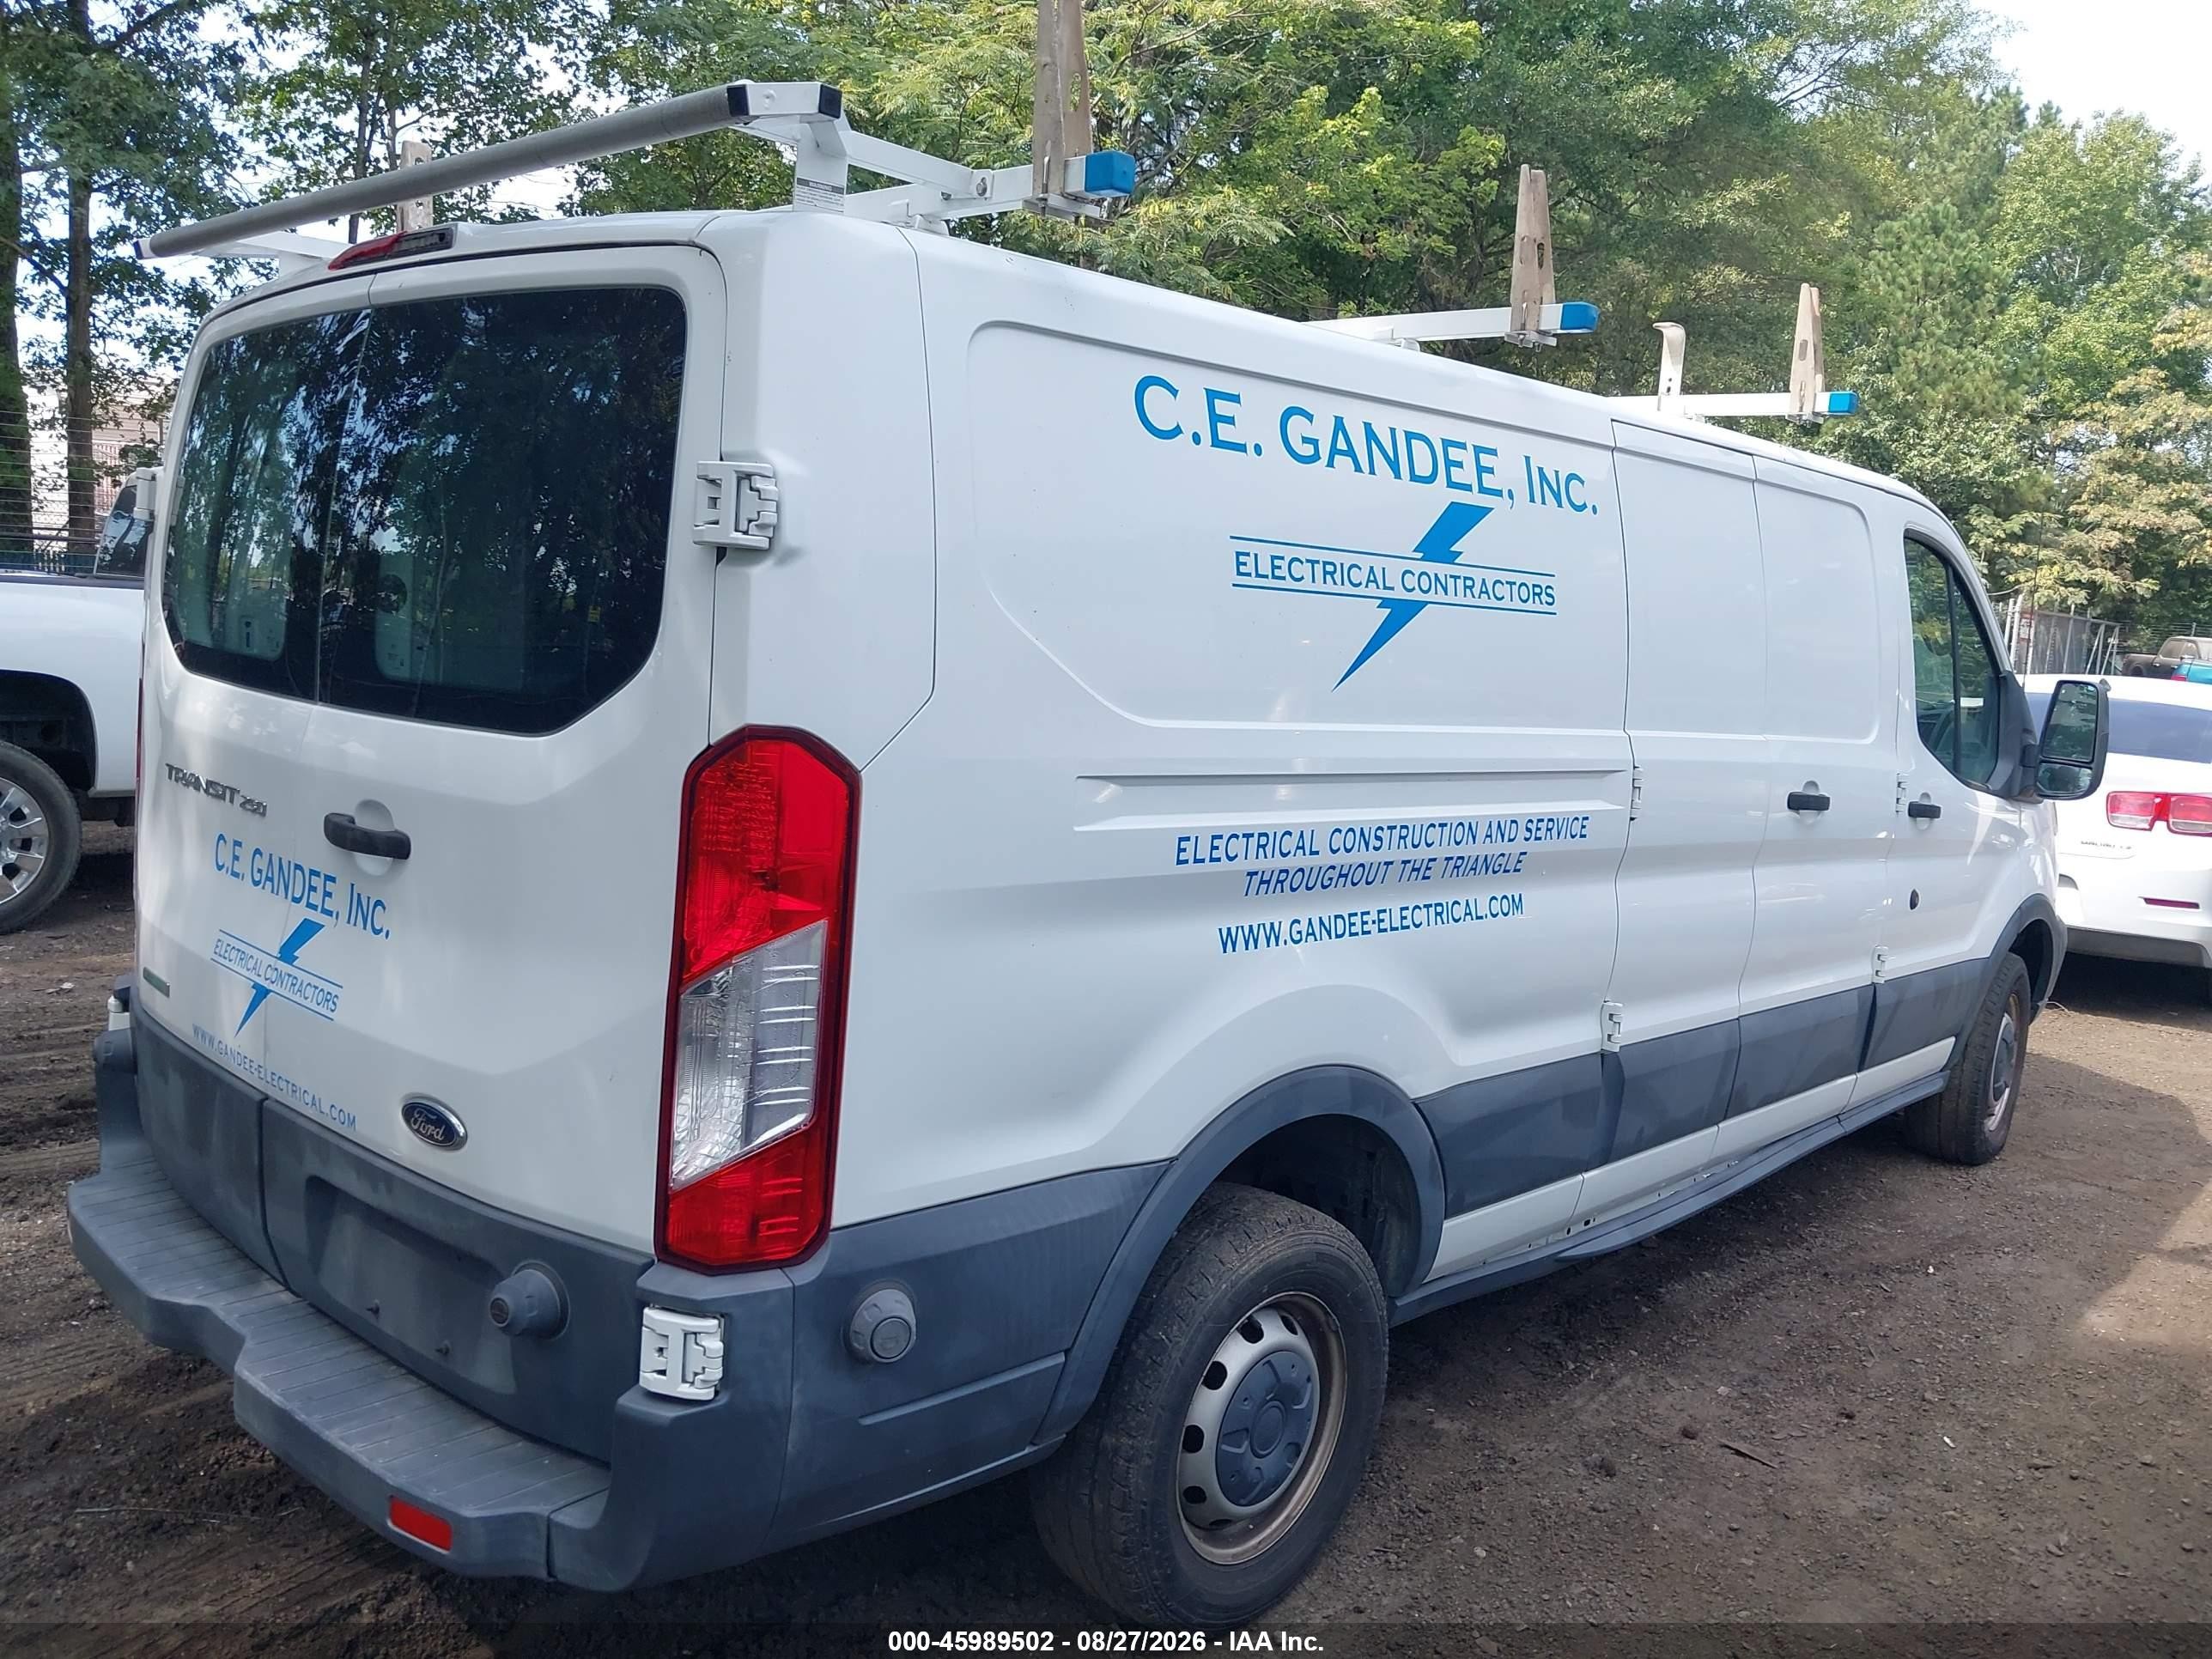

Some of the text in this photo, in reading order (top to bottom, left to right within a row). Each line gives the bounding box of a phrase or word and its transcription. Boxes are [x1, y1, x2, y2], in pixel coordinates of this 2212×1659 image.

[1134, 375, 1262, 457] C.E.
[1279, 405, 1515, 508] GANDEE,
[1234, 550, 1556, 606] ELECTRICAL CONTRACTORS
[165, 763, 240, 805] TRANSIT
[1176, 816, 1589, 866] ELECTRICAL CONSTRUCTION AND SERVICE
[215, 833, 245, 881] C.E.
[250, 848, 340, 927] GANDEE,
[1243, 851, 1528, 897] THROUGHOUT THE TRIANGLE
[1218, 893, 1523, 954] WWW.GANDEE-ELECTRICAL.COM
[214, 939, 339, 1013] ELECTRICAL CONTRACTORS
[191, 1023, 357, 1132] WWW.GANDEE-ELECTRICAL.COM
[410, 1108, 446, 1140] Ford
